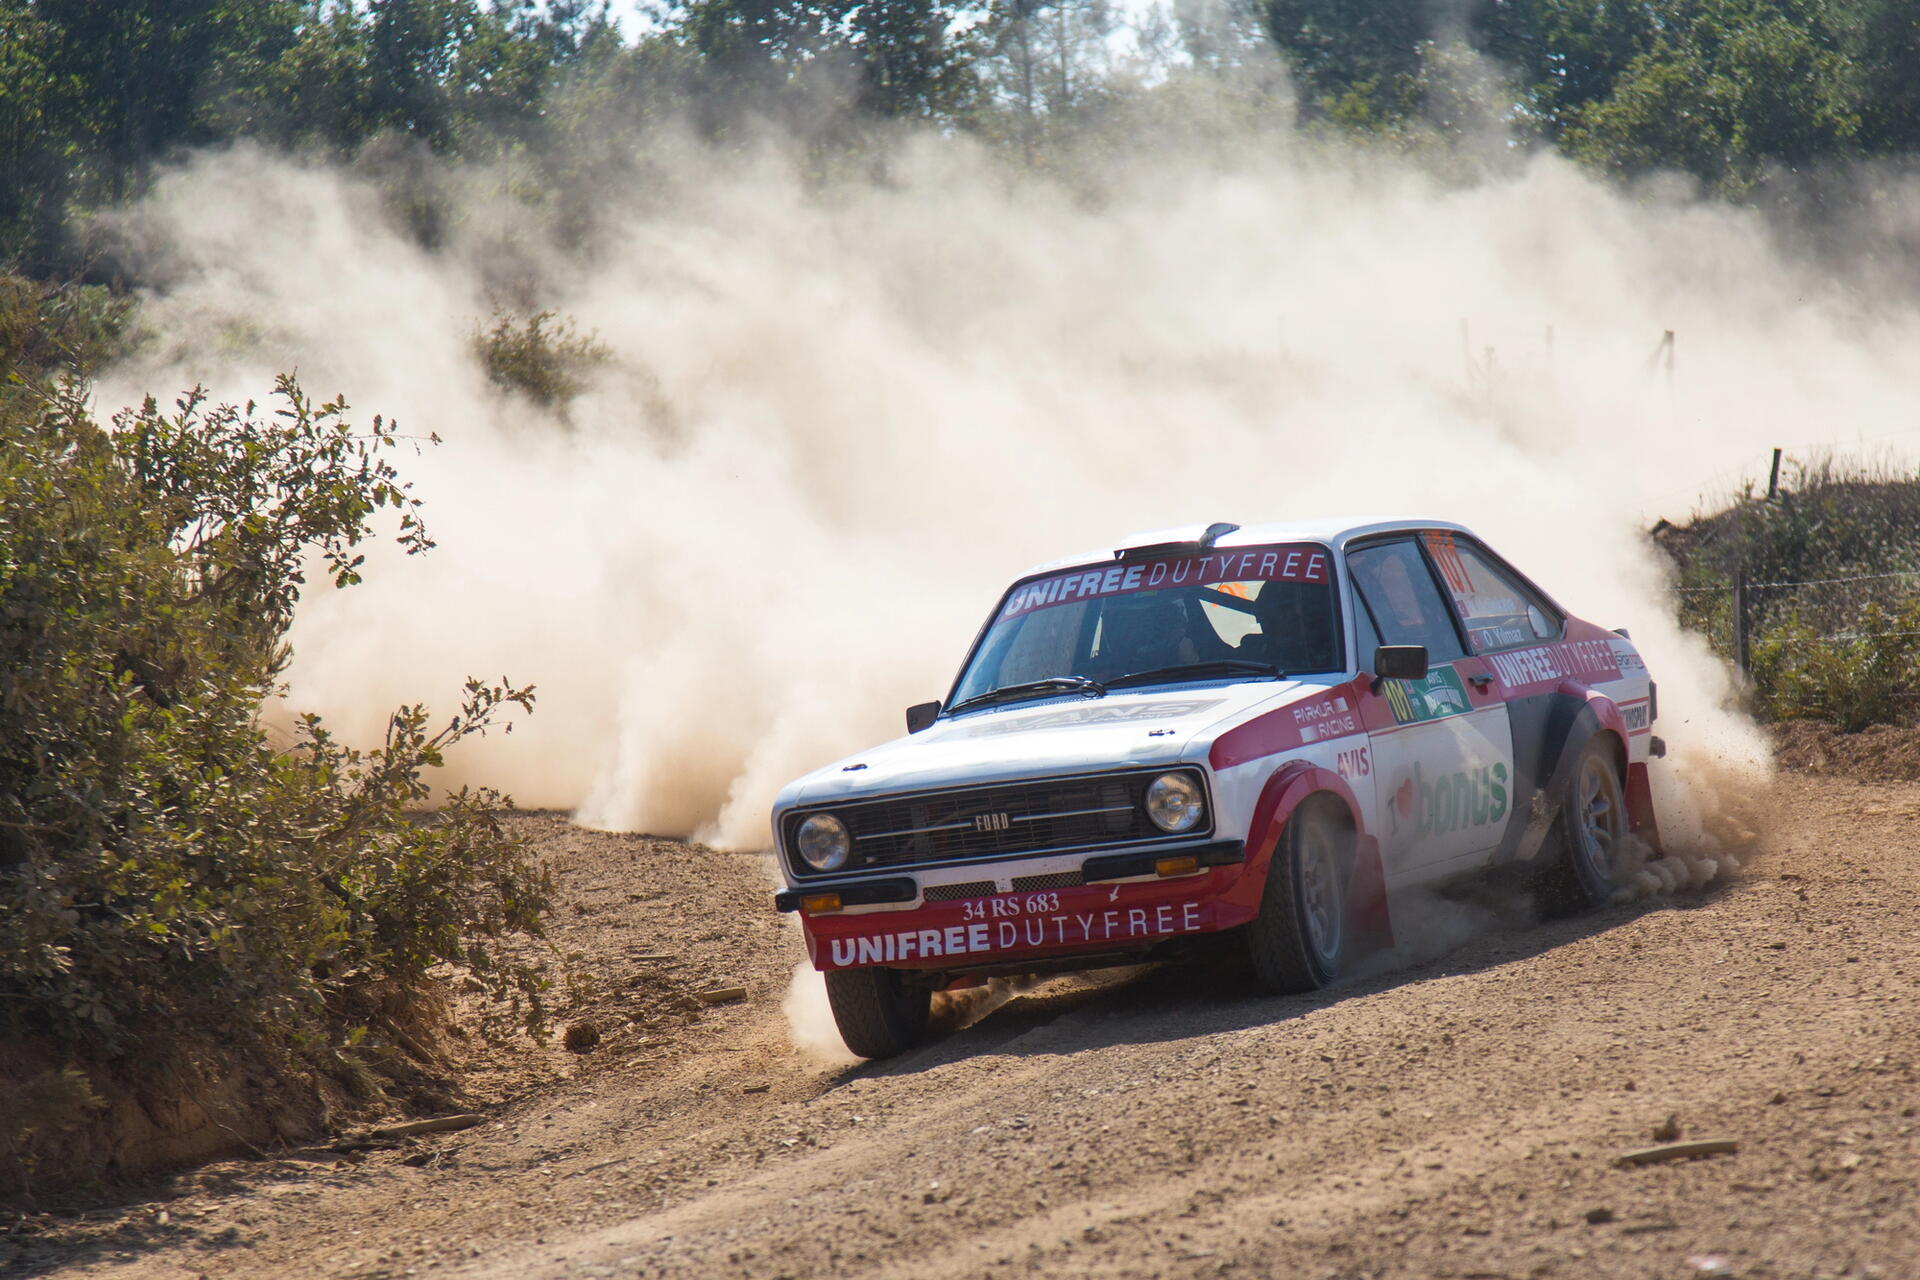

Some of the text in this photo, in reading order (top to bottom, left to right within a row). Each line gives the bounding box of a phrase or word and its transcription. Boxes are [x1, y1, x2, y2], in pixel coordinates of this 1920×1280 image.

[1004, 565, 1147, 617] UNIFREE
[1489, 646, 1557, 688] UNIFREE
[1383, 679, 1415, 721] 101
[1318, 716, 1355, 738] RACING
[1337, 747, 1370, 780] AVIS
[1414, 761, 1507, 839] bonus
[975, 812, 1009, 831] FORD
[962, 893, 1060, 920] 34 RS 683
[831, 903, 1201, 967] UNIFREE DUTYFREE
